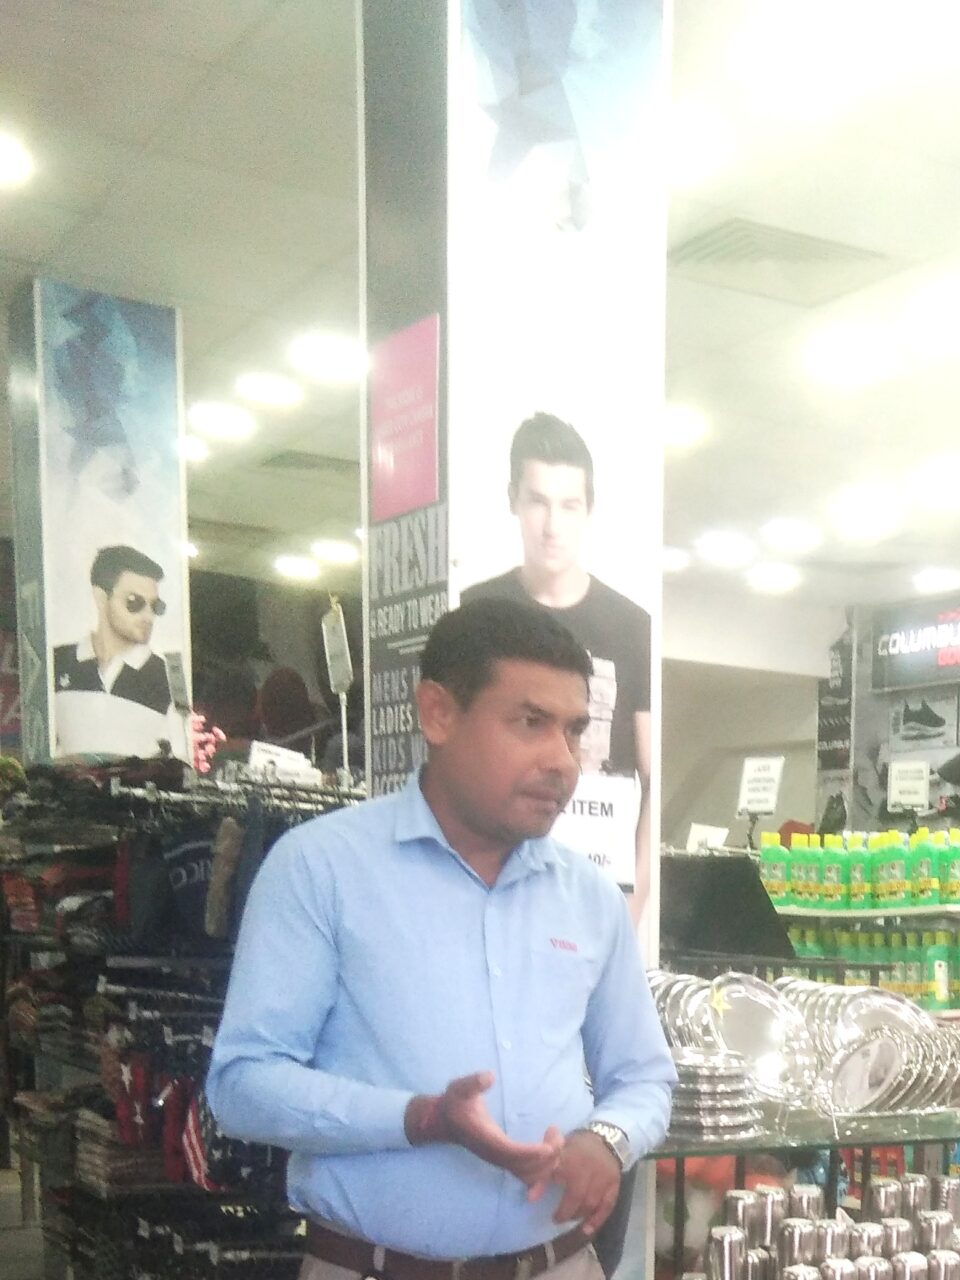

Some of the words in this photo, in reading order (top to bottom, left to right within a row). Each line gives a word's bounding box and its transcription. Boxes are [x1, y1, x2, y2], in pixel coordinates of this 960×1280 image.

[369, 503, 448, 600] FRESH
[407, 598, 419, 630] TO
[372, 702, 413, 735] LADIES
[373, 735, 407, 772] KIDS
[572, 799, 614, 819] ITEM
